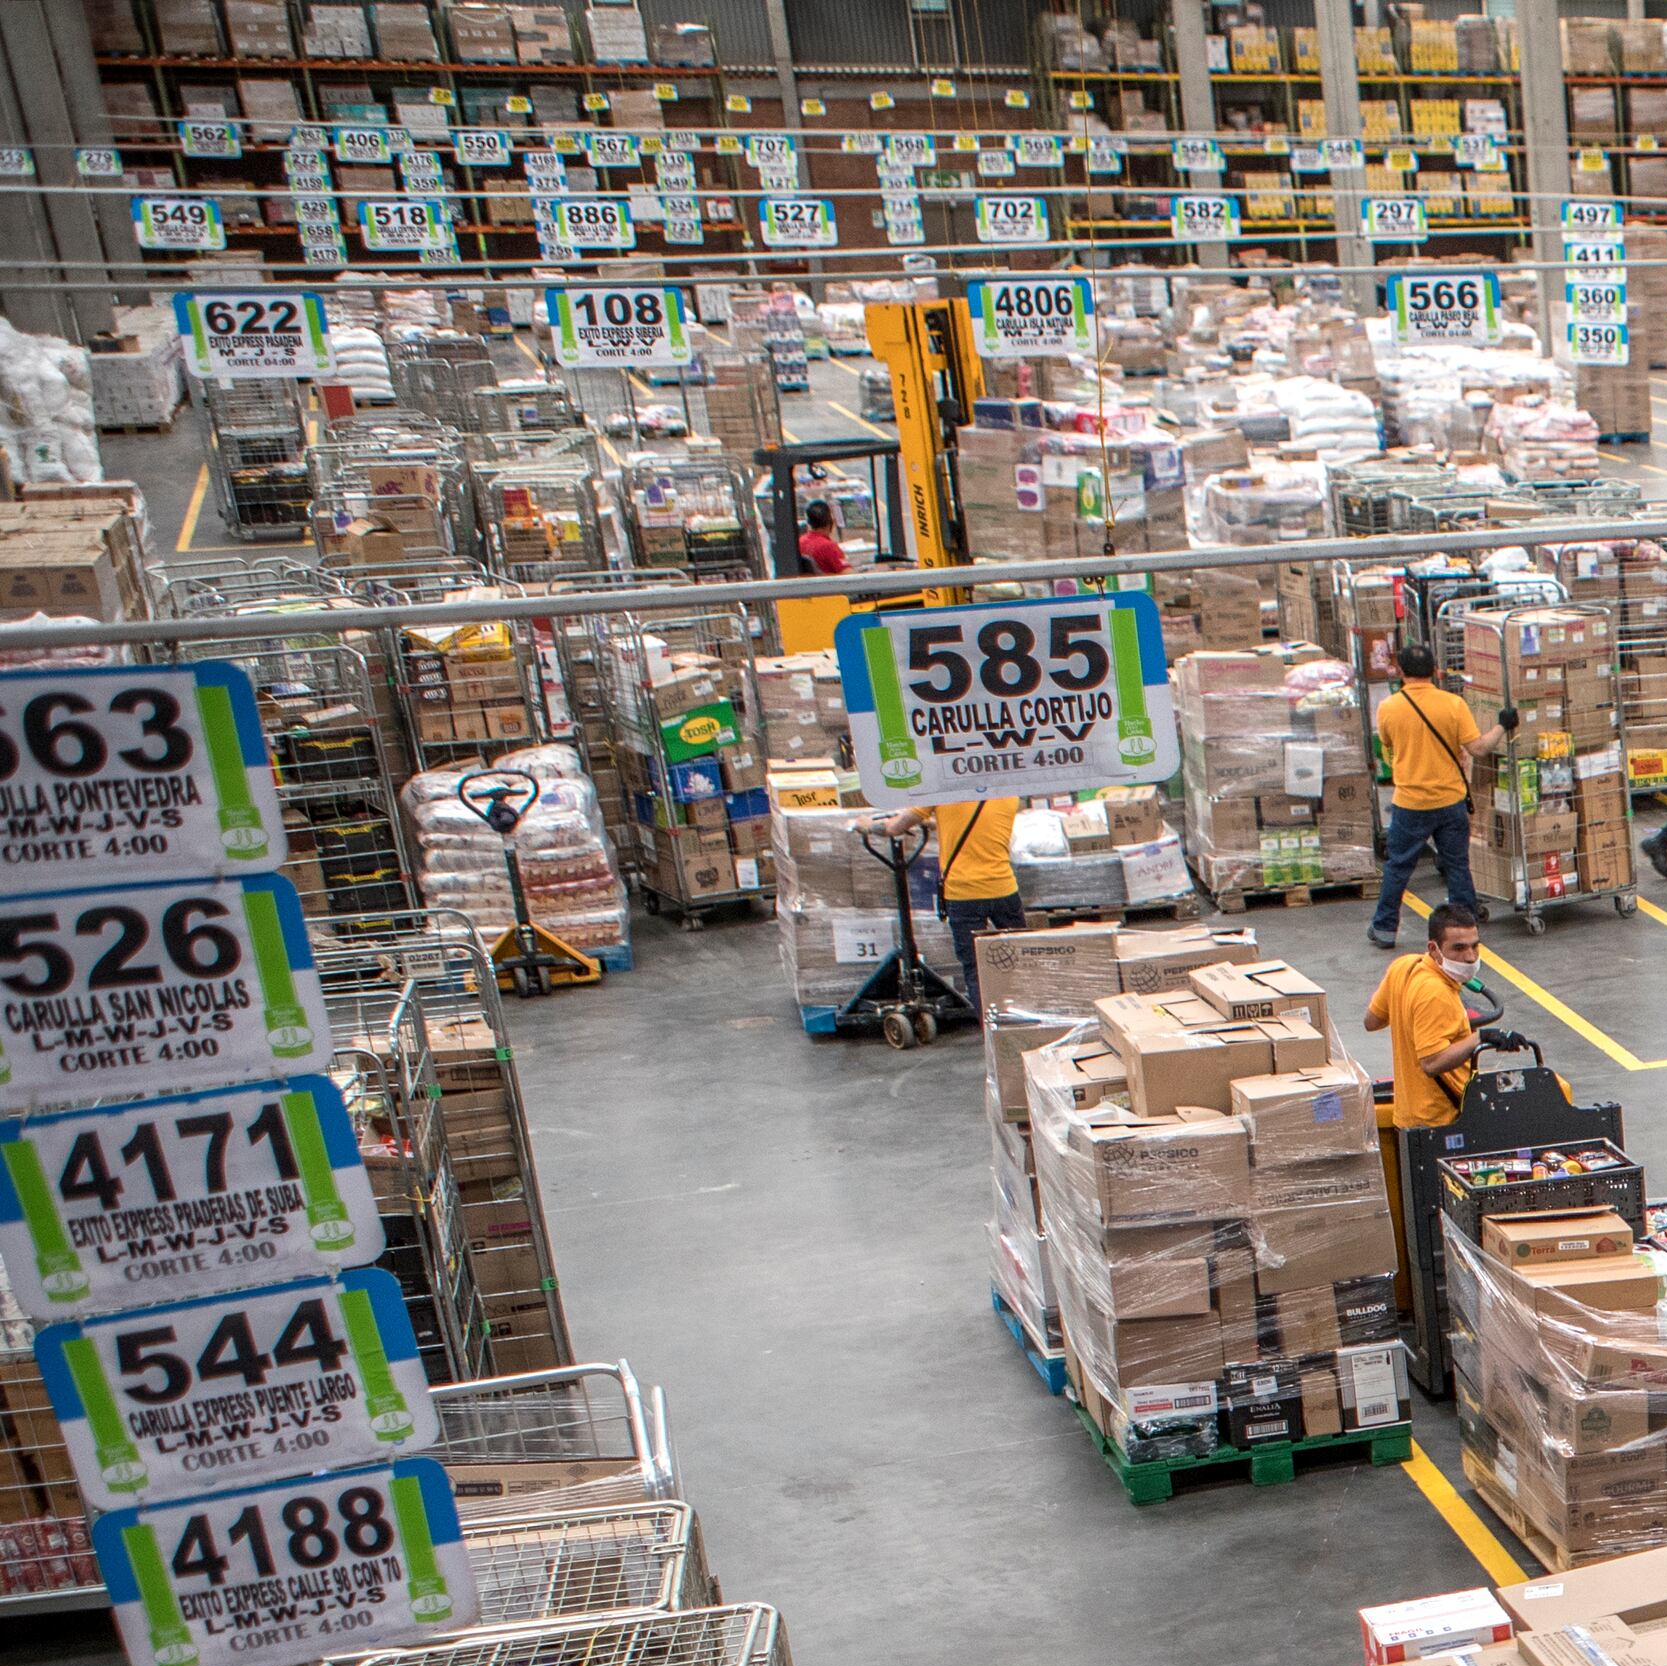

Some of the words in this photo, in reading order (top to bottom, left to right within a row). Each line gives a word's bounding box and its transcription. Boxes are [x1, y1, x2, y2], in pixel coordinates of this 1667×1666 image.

[191, 127, 228, 141] 562
[345, 134, 379, 147] 406
[463, 137, 498, 150] 550
[596, 138, 627, 151] 567
[152, 206, 206, 224] 549
[301, 202, 327, 213] 429
[375, 206, 426, 224] 518
[567, 206, 617, 224] 886
[774, 204, 819, 221] 527
[989, 202, 1032, 217] 702
[1183, 202, 1224, 218] 582
[1376, 203, 1415, 219] 297
[1573, 207, 1609, 223] 497
[307, 225, 333, 237] 658
[1576, 249, 1614, 262] 411
[996, 287, 1073, 316] 4806
[1409, 281, 1479, 309] 566
[1579, 289, 1616, 304] 360
[205, 301, 302, 335] 622
[575, 293, 664, 326] 108
[996, 318, 1027, 329] CARULLA
[209, 336, 231, 349] EXITO
[231, 336, 264, 349] EXPRESS
[265, 336, 304, 348] PASADENA
[578, 327, 600, 339] EXITO
[602, 327, 634, 339] EXPRESS
[636, 327, 664, 339] SIBERIA
[1578, 328, 1616, 344] 350
[227, 358, 262, 367] CORTE
[909, 614, 1110, 703] 585
[912, 703, 1011, 737] CARULLA
[1019, 692, 1113, 728] CORTIJO
[685, 721, 716, 739] TOSH
[933, 722, 1095, 754] L-W-V
[952, 752, 1026, 775] CORTE
[1033, 747, 1084, 766] 4:00
[53, 774, 202, 814] PONTEVEDRA
[4, 837, 96, 864] CORTE
[104, 834, 168, 856] 4:00
[0, 898, 242, 997] 526
[857, 942, 878, 958] 31
[5, 993, 112, 1034] CARULLA
[112, 987, 155, 1023] SAN
[157, 979, 250, 1017] NICOLAS
[32, 1012, 234, 1052] L-M-W-J-V-S
[60, 1045, 151, 1074] CORTE
[158, 1038, 220, 1061] 4:00
[59, 1102, 300, 1211] 4171
[68, 1213, 113, 1249] EXITO
[112, 1206, 175, 1242] EXPRESS
[174, 1196, 246, 1233] PRADERAS
[268, 1183, 305, 1215] SUBA
[97, 1216, 290, 1263] L-M-W-J-V-S
[1530, 1246, 1557, 1255] Terra
[124, 1252, 210, 1282] CORTE
[218, 1241, 277, 1265] 4:00
[1346, 1303, 1388, 1319] BULLDOG
[116, 1299, 348, 1405] 544
[129, 1405, 196, 1439] CARULLA
[195, 1394, 256, 1427] EXPRESS
[255, 1383, 312, 1418] PUENTE
[309, 1372, 358, 1404] LARGO
[155, 1405, 342, 1454] L-M-W-J-V-S
[182, 1444, 265, 1472] CORTE
[273, 1430, 330, 1455] 4:00
[171, 1487, 395, 1586] 4188
[179, 1590, 224, 1621] EXITO
[224, 1580, 289, 1614] EXPRESS
[288, 1571, 333, 1604] CALLE
[205, 1588, 387, 1637] L-M-W-J-V-S
[229, 1625, 313, 1652] CORTE
[318, 1610, 374, 1635] 4:00
